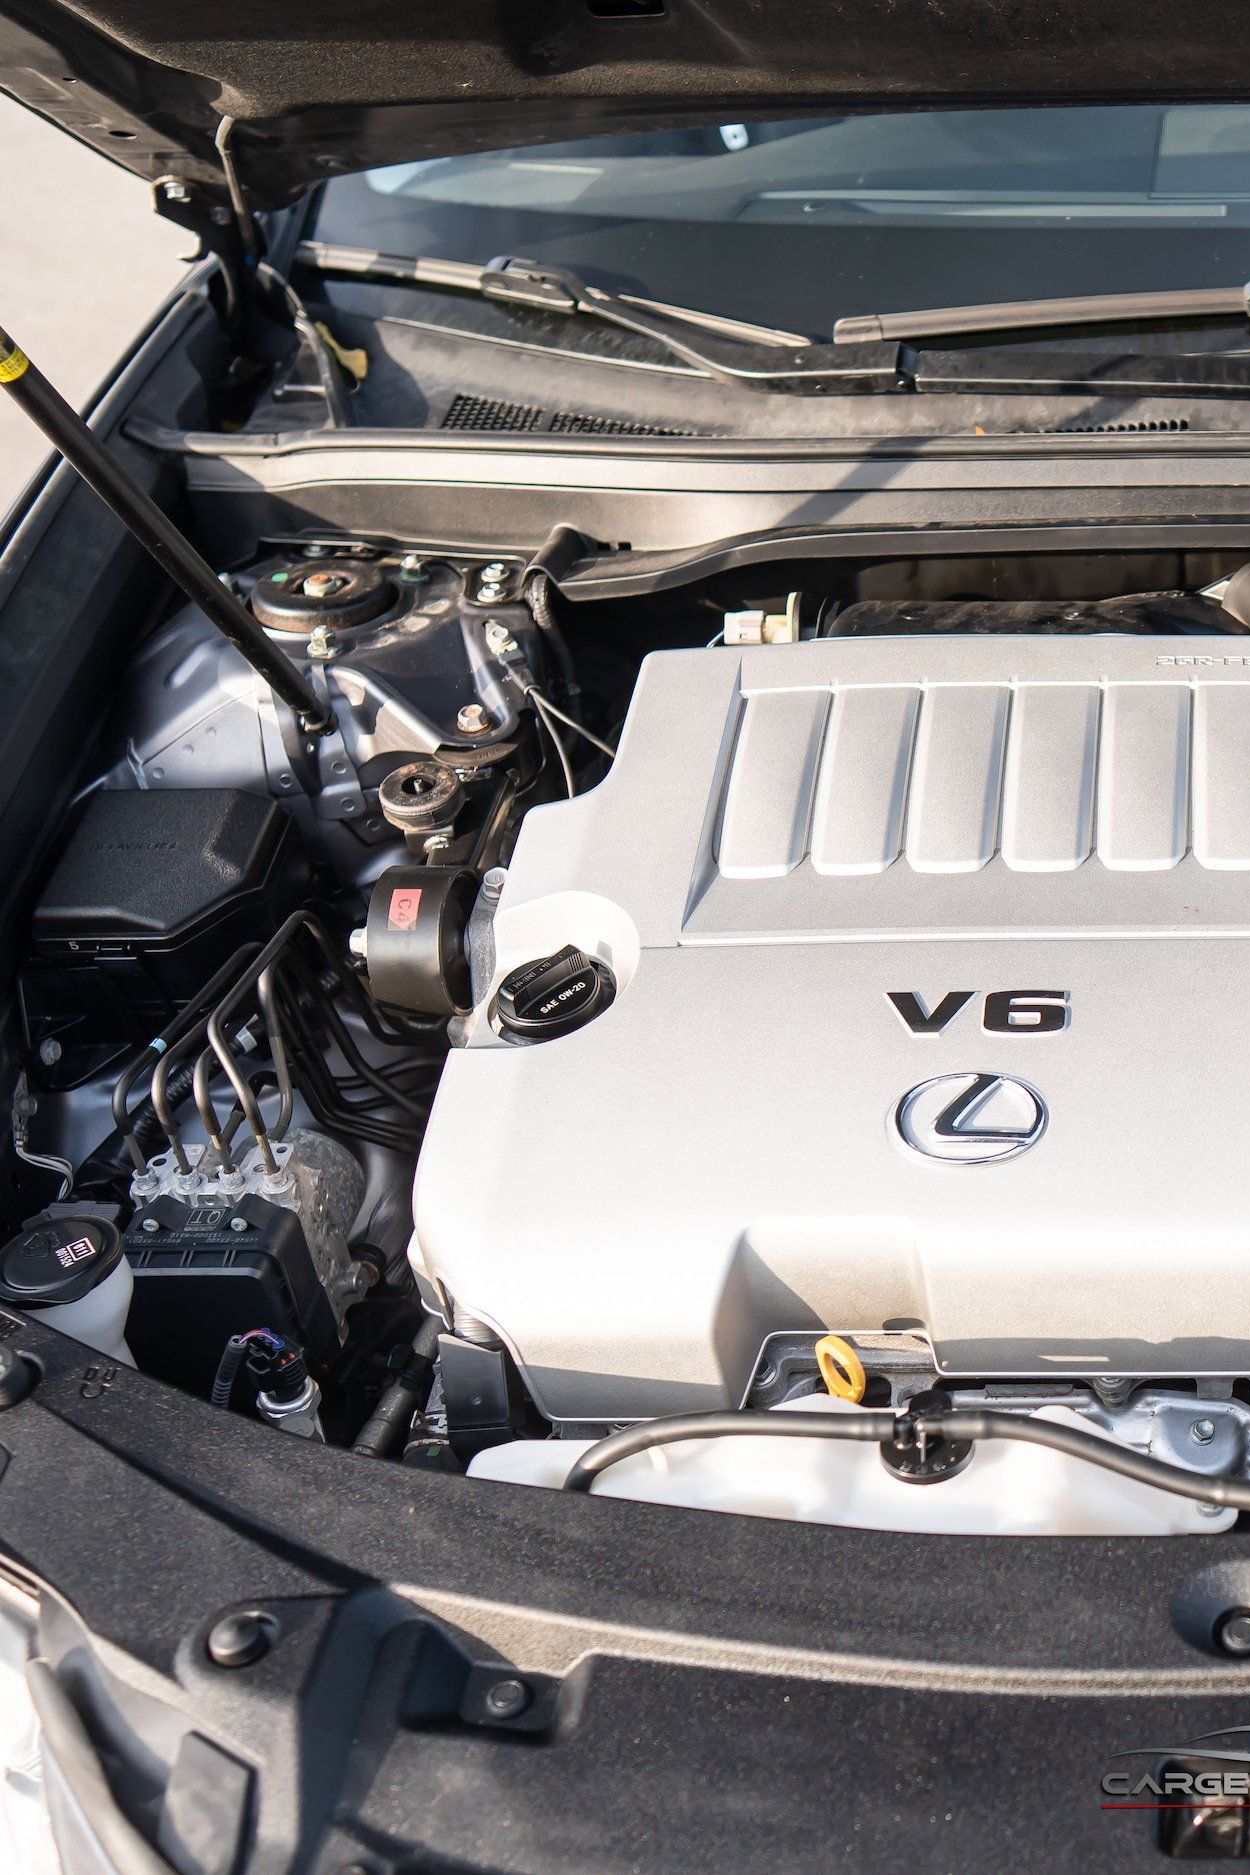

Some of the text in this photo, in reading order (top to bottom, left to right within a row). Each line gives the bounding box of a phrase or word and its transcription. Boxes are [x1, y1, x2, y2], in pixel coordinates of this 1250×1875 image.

[539, 980, 587, 1015] SAE 0W-20
[884, 989, 1072, 1038] V6
